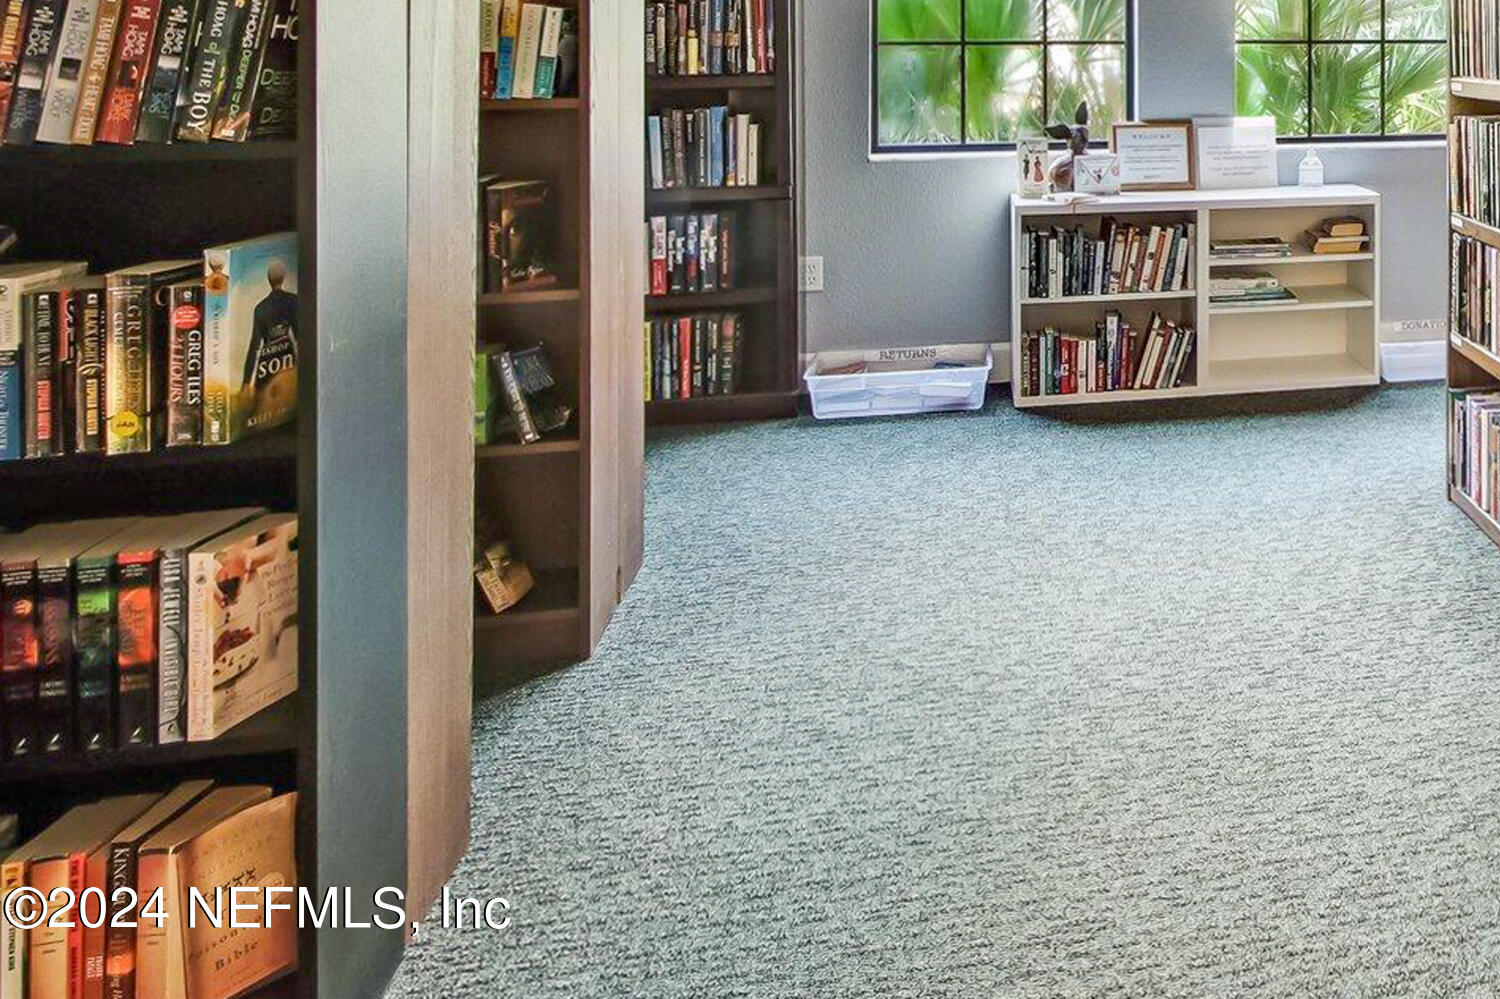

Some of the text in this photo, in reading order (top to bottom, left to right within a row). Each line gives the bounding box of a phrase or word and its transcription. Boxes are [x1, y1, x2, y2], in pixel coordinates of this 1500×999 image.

[210, 0, 228, 38] HOAG
[242, 13, 259, 49] HOAG
[26, 23, 42, 56] HOAG
[39, 28, 53, 54] TAMI
[90, 17, 115, 71] TAMI HOAG
[121, 25, 137, 60] HOAG
[133, 31, 149, 56] TAMI
[161, 23, 176, 56] HOAG
[174, 28, 187, 52] TAMI
[234, 49, 252, 89] DEEPER
[186, 59, 216, 133] THE BOY
[83, 308, 99, 364] BLACK LIGHT
[127, 305, 142, 361] GREG
[187, 330, 200, 405] GREG ILES
[879, 348, 937, 360] RETURNS
[170, 353, 183, 403] HOURS
[162, 557, 180, 626] LISA JEWELL
